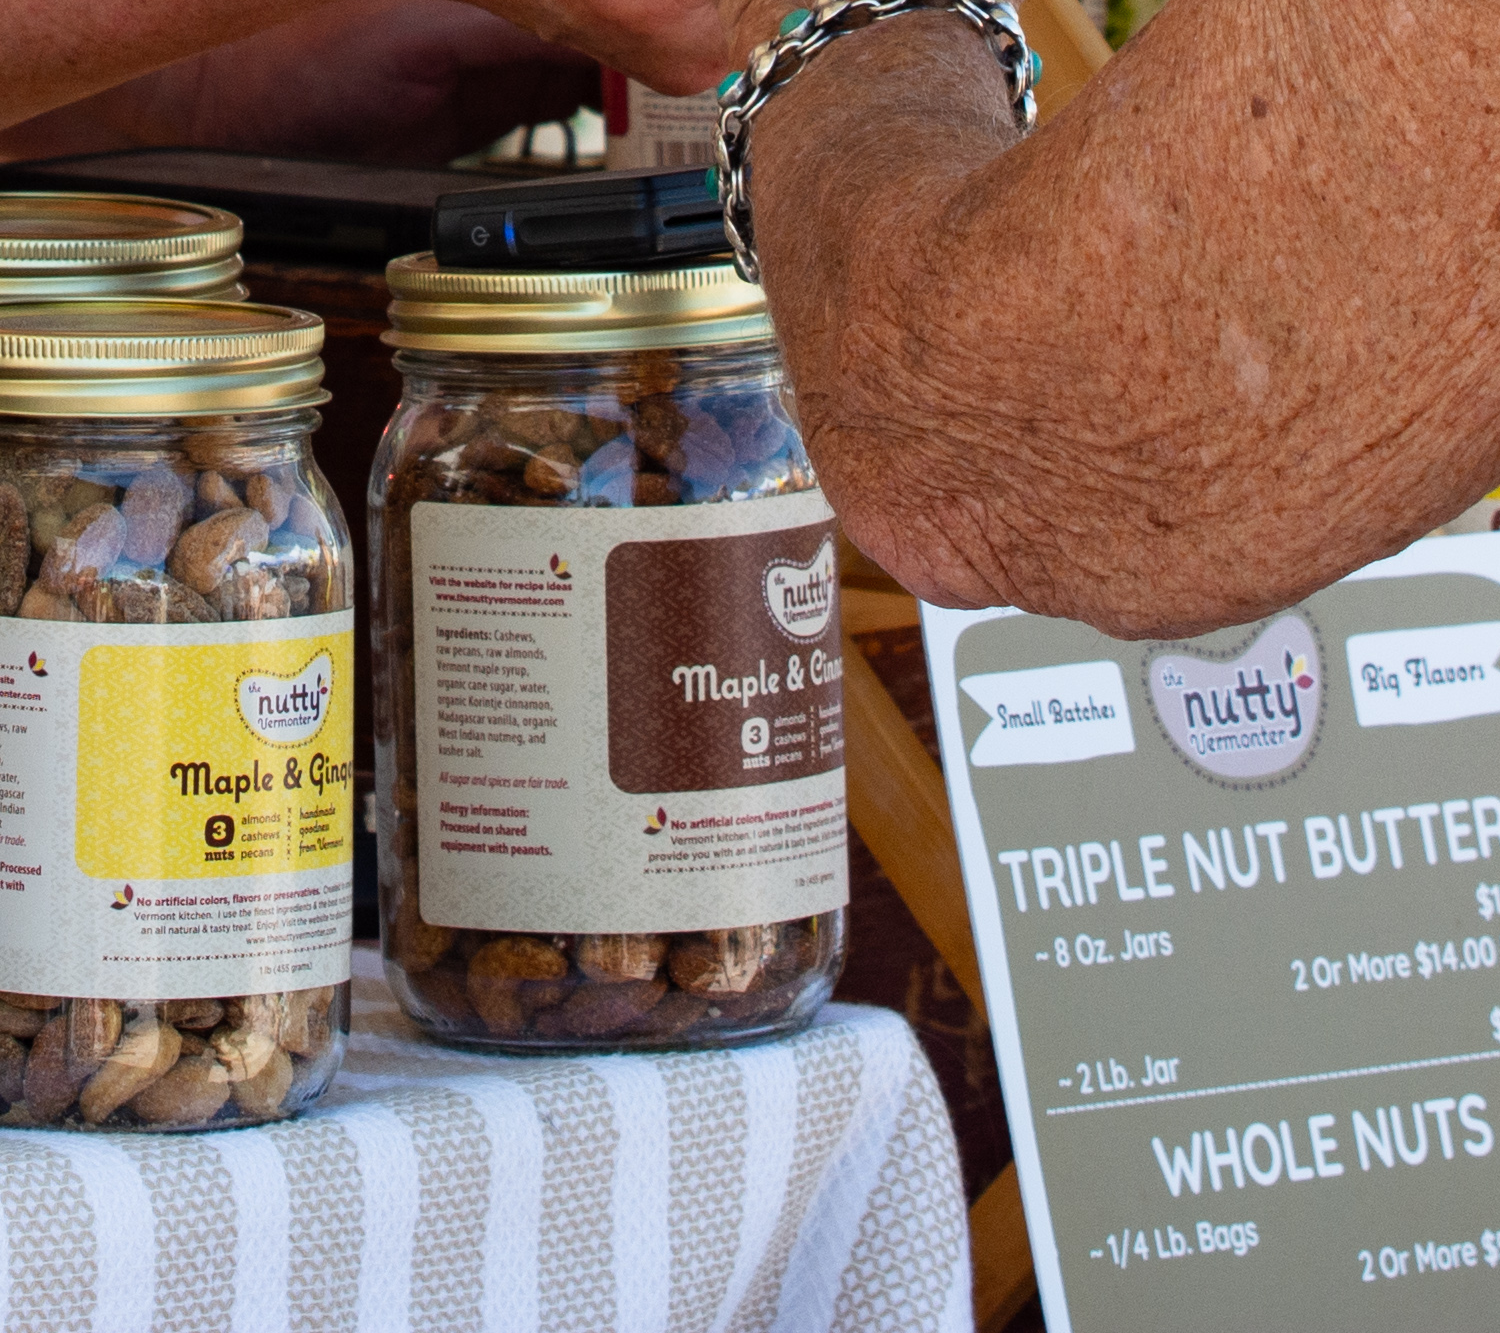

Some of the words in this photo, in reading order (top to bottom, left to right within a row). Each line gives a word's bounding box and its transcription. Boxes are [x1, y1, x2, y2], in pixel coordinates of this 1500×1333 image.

[1162, 667, 1183, 687] the
[1362, 663, 1400, 696] Big
[1405, 658, 1484, 686] Flavors
[257, 680, 320, 720] nutty
[997, 701, 1045, 729] Small
[1049, 696, 1115, 724] Batches
[1182, 670, 1302, 739] nutty
[257, 714, 311, 729] Vermonter
[1189, 727, 1286, 757] Vermonter
[170, 760, 273, 802] Maple
[284, 755, 303, 791] &
[999, 835, 1175, 912] TRIPLE
[1183, 821, 1287, 892] NUT
[1055, 938, 1070, 967] 8
[1075, 934, 1114, 965] Oz.
[1121, 930, 1173, 960] Jars
[1291, 960, 1309, 990] 2
[1312, 957, 1342, 987] Or
[1348, 952, 1411, 982] More
[1415, 936, 1496, 979] $14.00
[1077, 1063, 1094, 1094] 2
[1097, 1058, 1135, 1091] Lb.
[1142, 1056, 1179, 1086] Jar
[1152, 1114, 1344, 1196] WHOLE
[1353, 1094, 1493, 1170] NUTS
[1107, 1229, 1149, 1268] 1/4
[1154, 1226, 1193, 1258] Lb.
[1196, 1222, 1259, 1256] Bags
[1359, 1250, 1375, 1281] 2
[1379, 1247, 1409, 1278] Or
[1415, 1242, 1477, 1272] More
